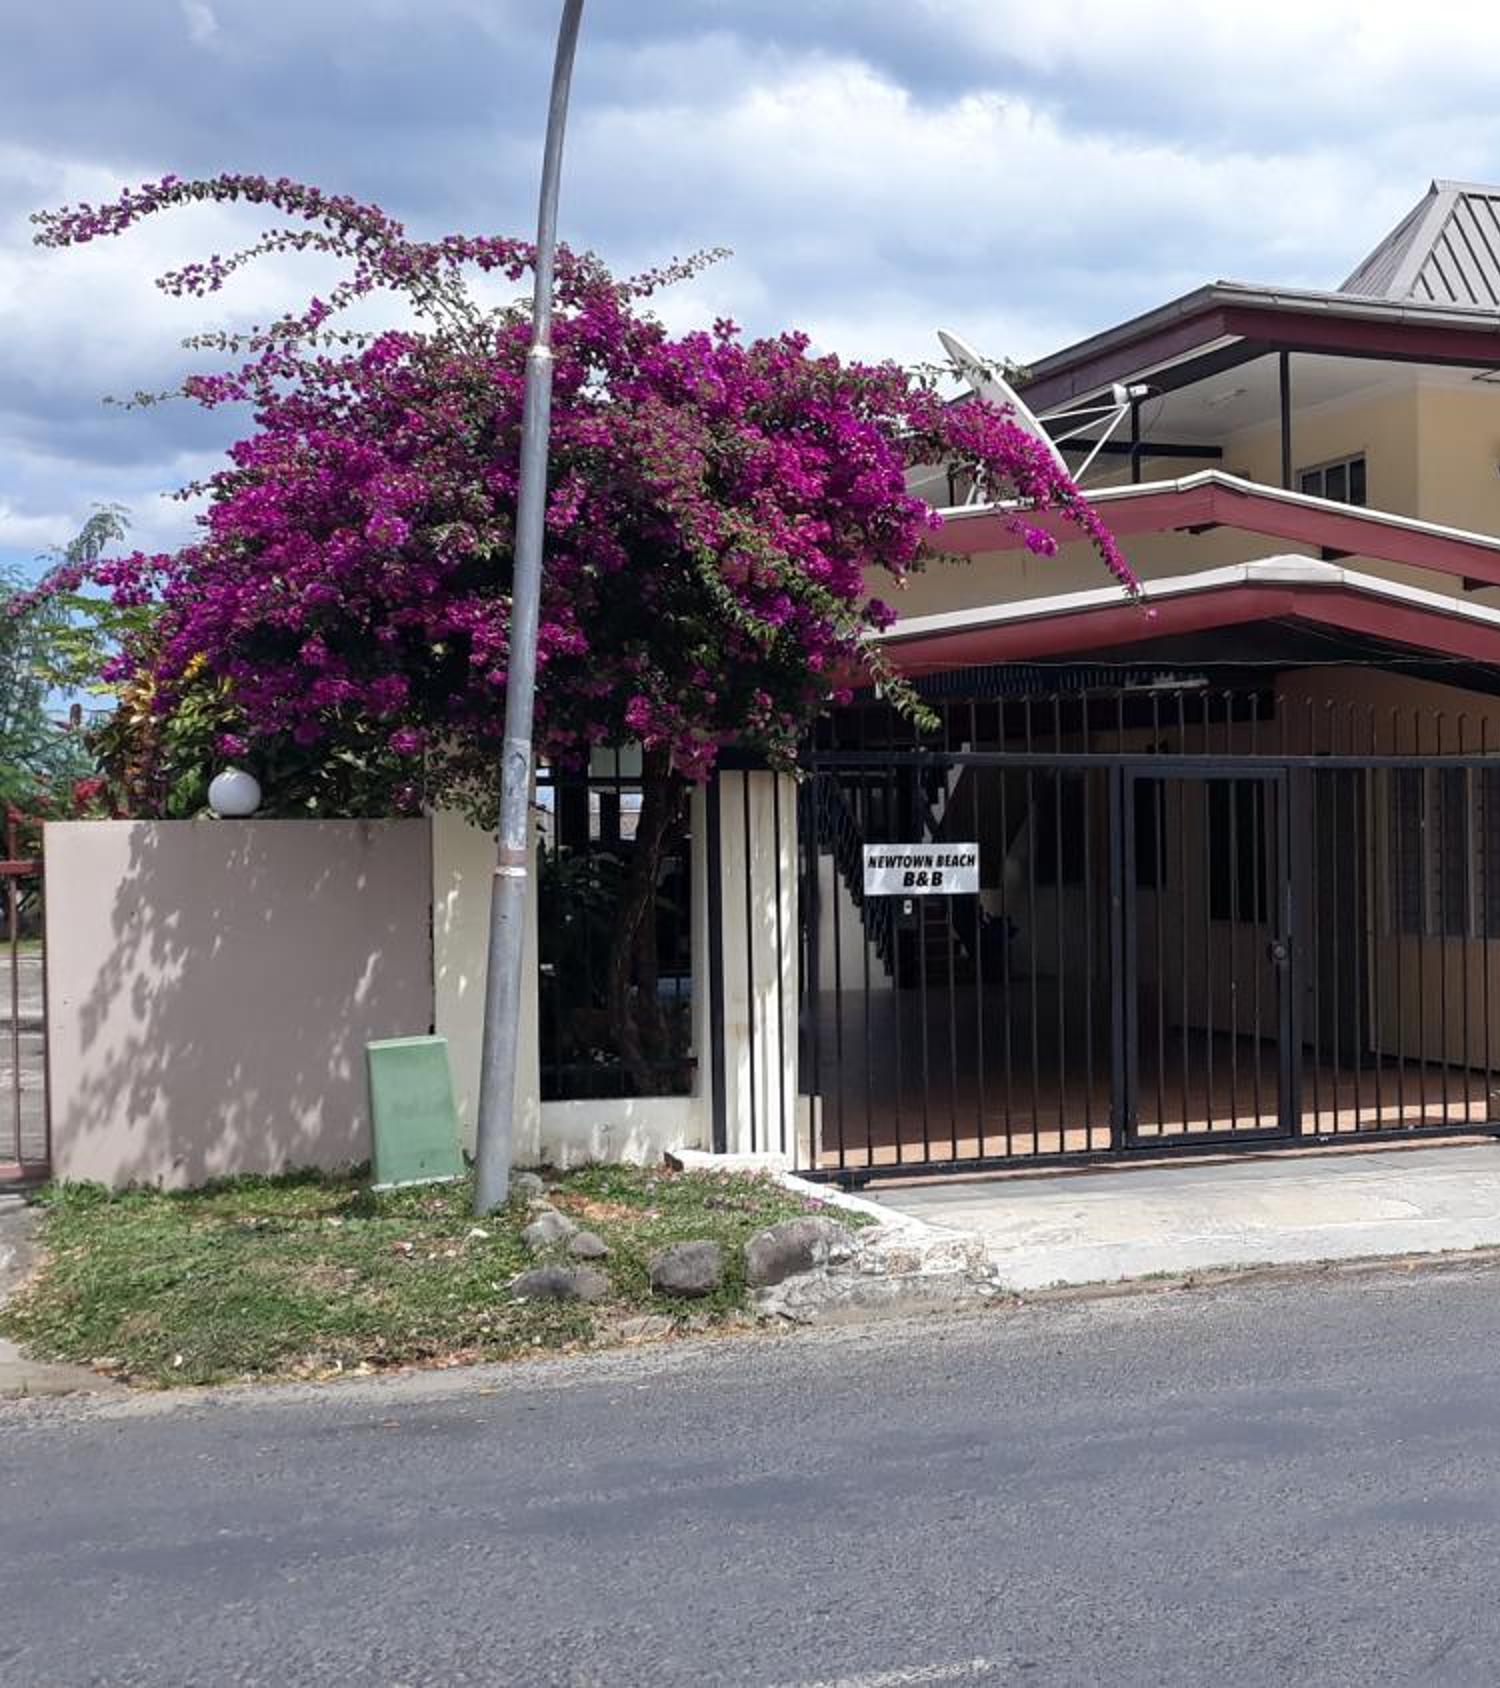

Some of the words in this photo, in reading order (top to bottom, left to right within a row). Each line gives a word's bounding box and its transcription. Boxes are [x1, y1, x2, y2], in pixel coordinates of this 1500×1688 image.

[868, 855, 933, 869] NEWTOWN
[936, 854, 975, 868] BEACH
[903, 871, 943, 887] B&B
